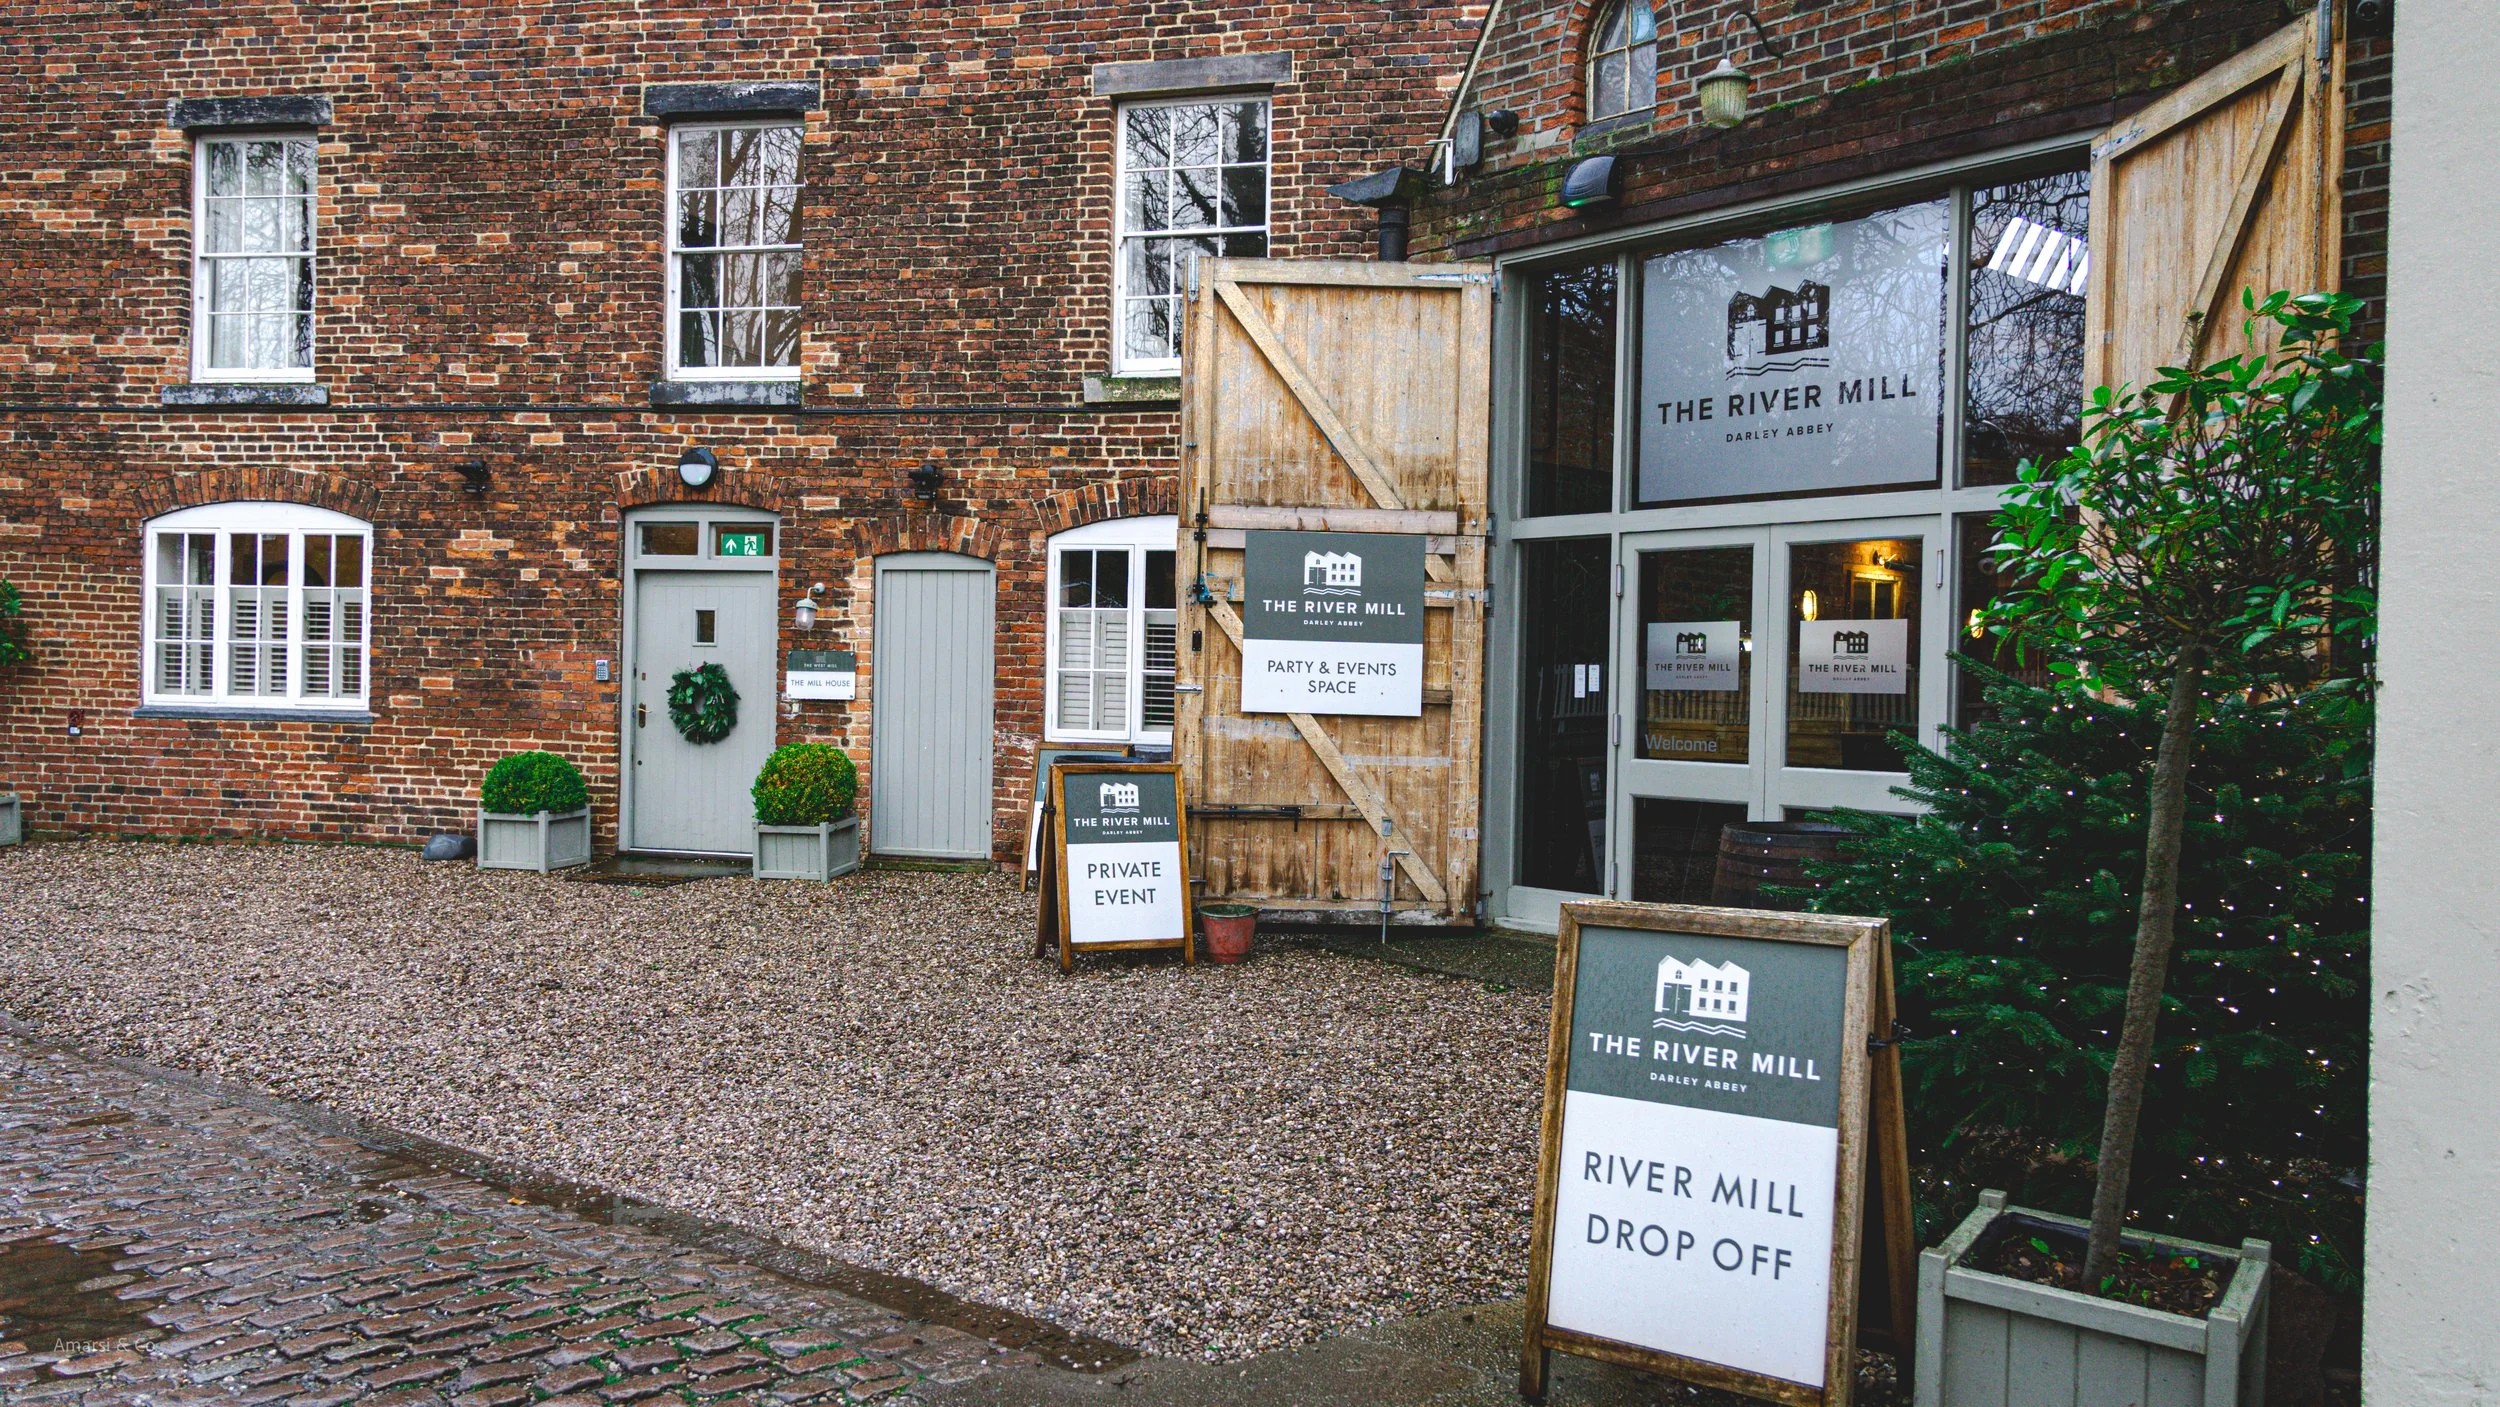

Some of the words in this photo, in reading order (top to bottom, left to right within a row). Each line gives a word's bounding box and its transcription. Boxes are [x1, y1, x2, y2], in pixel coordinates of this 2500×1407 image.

[1657, 397, 1713, 425] THE
[1728, 384, 1822, 417] RIVER
[1838, 373, 1917, 405] MILL
[1725, 428, 1779, 443] DARLEY
[1786, 422, 1834, 437] ABBEY
[1262, 599, 1297, 612] THE
[1304, 601, 1357, 614] RIVER
[1365, 603, 1406, 616] MILL
[1267, 660, 1314, 674] PARTY
[1318, 661, 1331, 675] &
[1337, 662, 1397, 676] EVENTS
[1655, 663, 1673, 671] THE
[1676, 663, 1705, 671] RIVER
[1709, 663, 1731, 671] MILL
[1808, 664, 1829, 672] THE
[1833, 664, 1866, 673] RIVER
[1871, 664, 1897, 673] MILL
[1307, 680, 1356, 694] SPACE
[1644, 733, 1717, 753] Welcome
[1073, 818, 1098, 827] THE
[1102, 817, 1138, 827] RIVER
[1143, 816, 1170, 826] MILL
[1087, 861, 1161, 879] PRIVATE
[1095, 888, 1156, 906] EVENT
[1589, 1032, 1641, 1057] THE
[1653, 1040, 1738, 1070] RIVER
[1752, 1052, 1821, 1081] MILL
[1650, 1072, 1699, 1087] DARLEY
[1704, 1080, 1748, 1094] ABBEY
[1583, 1150, 1693, 1199] RIVER
[1711, 1172, 1804, 1218] MILL
[1586, 1213, 1695, 1261] DROP
[1713, 1237, 1792, 1281] OFF
